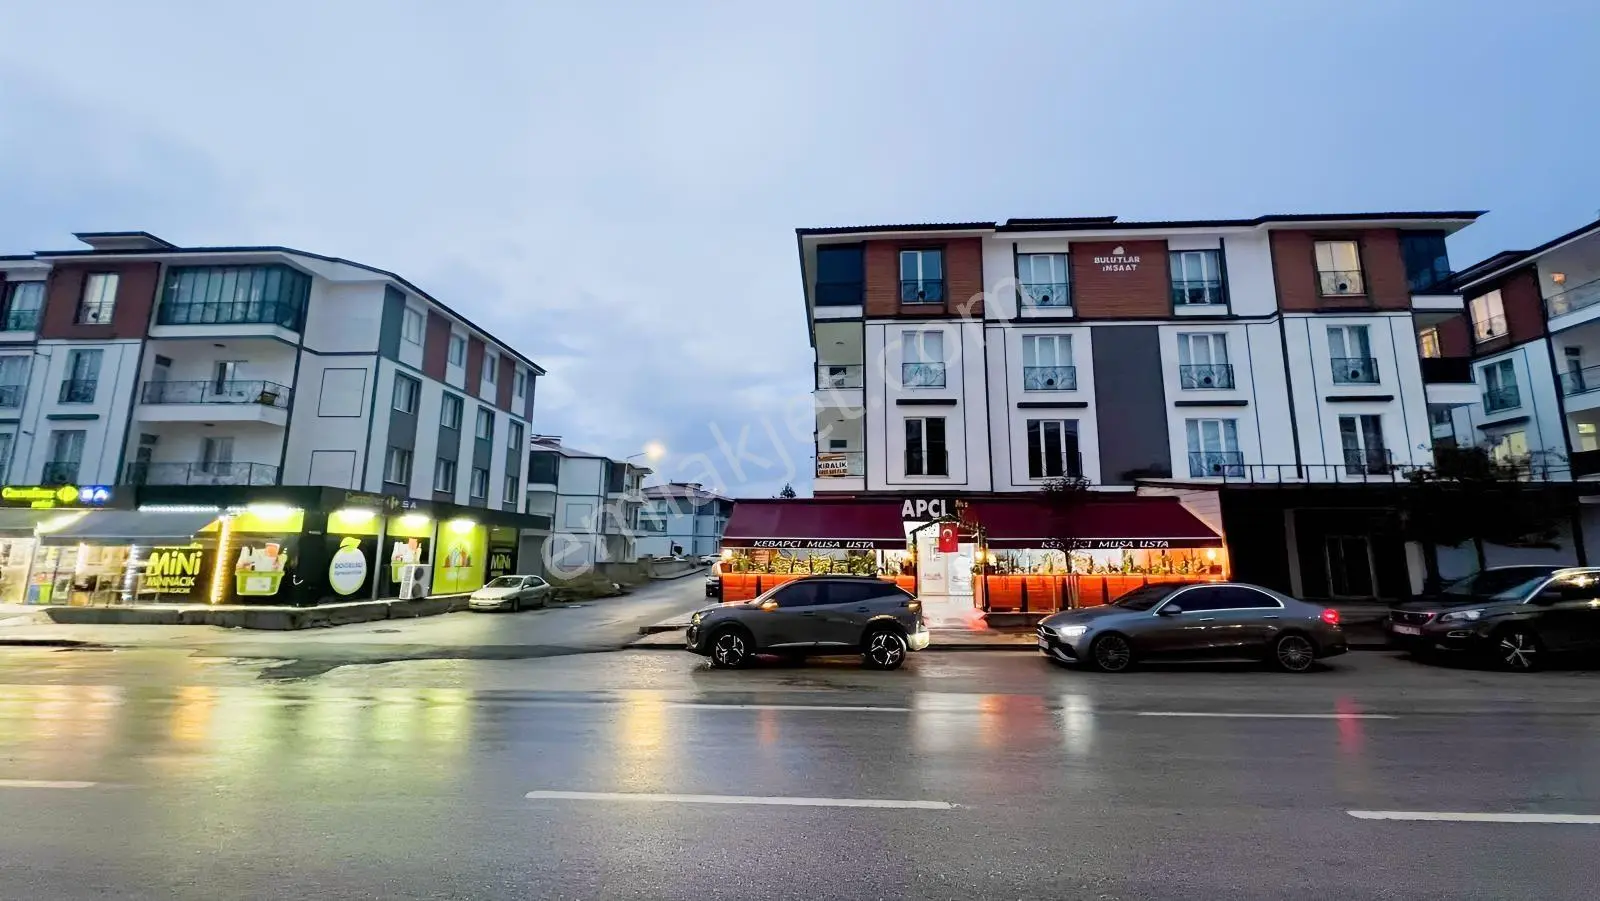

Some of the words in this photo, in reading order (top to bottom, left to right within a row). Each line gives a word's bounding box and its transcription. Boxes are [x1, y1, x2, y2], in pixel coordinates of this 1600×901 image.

[1094, 256, 1140, 264] BULUTLAR
[902, 499, 946, 518] APCI
[753, 540, 801, 548] KEBAPCI
[1098, 540, 1134, 548] MUSA
[1139, 540, 1169, 548] USTA
